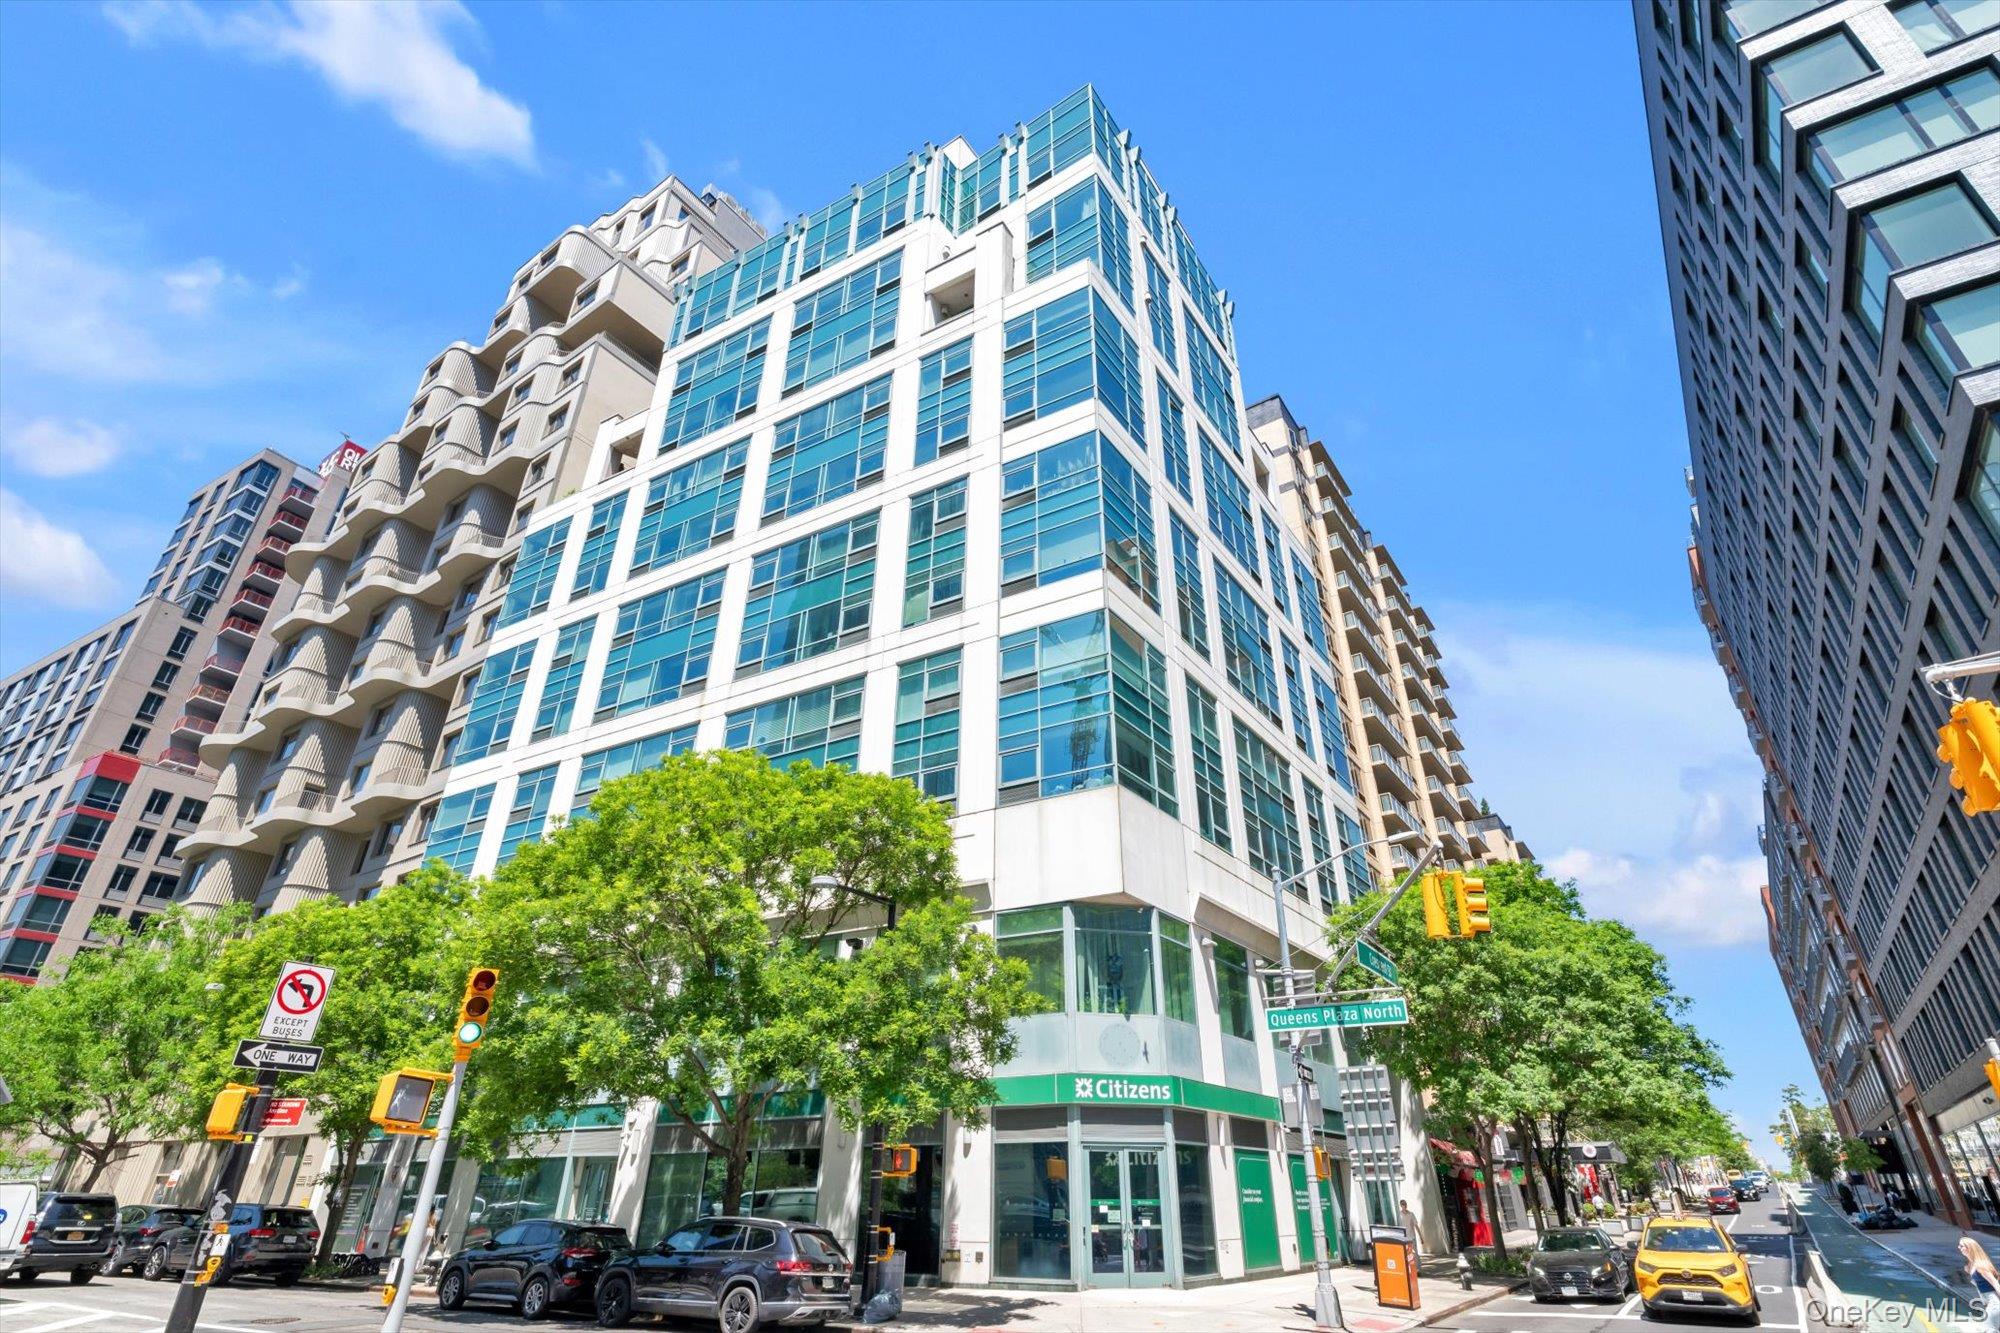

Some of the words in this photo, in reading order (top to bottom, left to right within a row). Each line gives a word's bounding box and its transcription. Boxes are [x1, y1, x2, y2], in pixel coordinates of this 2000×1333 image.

[273, 1016, 308, 1028] EXCEPT
[1270, 1012, 1318, 1026] Queens
[1323, 1009, 1358, 1022] Plaza
[1364, 1005, 1403, 1019] North
[272, 1026, 303, 1038] BUSES
[253, 1049, 278, 1062] ONE
[287, 1052, 313, 1065] WAY
[1095, 1079, 1171, 1099] Citizens
